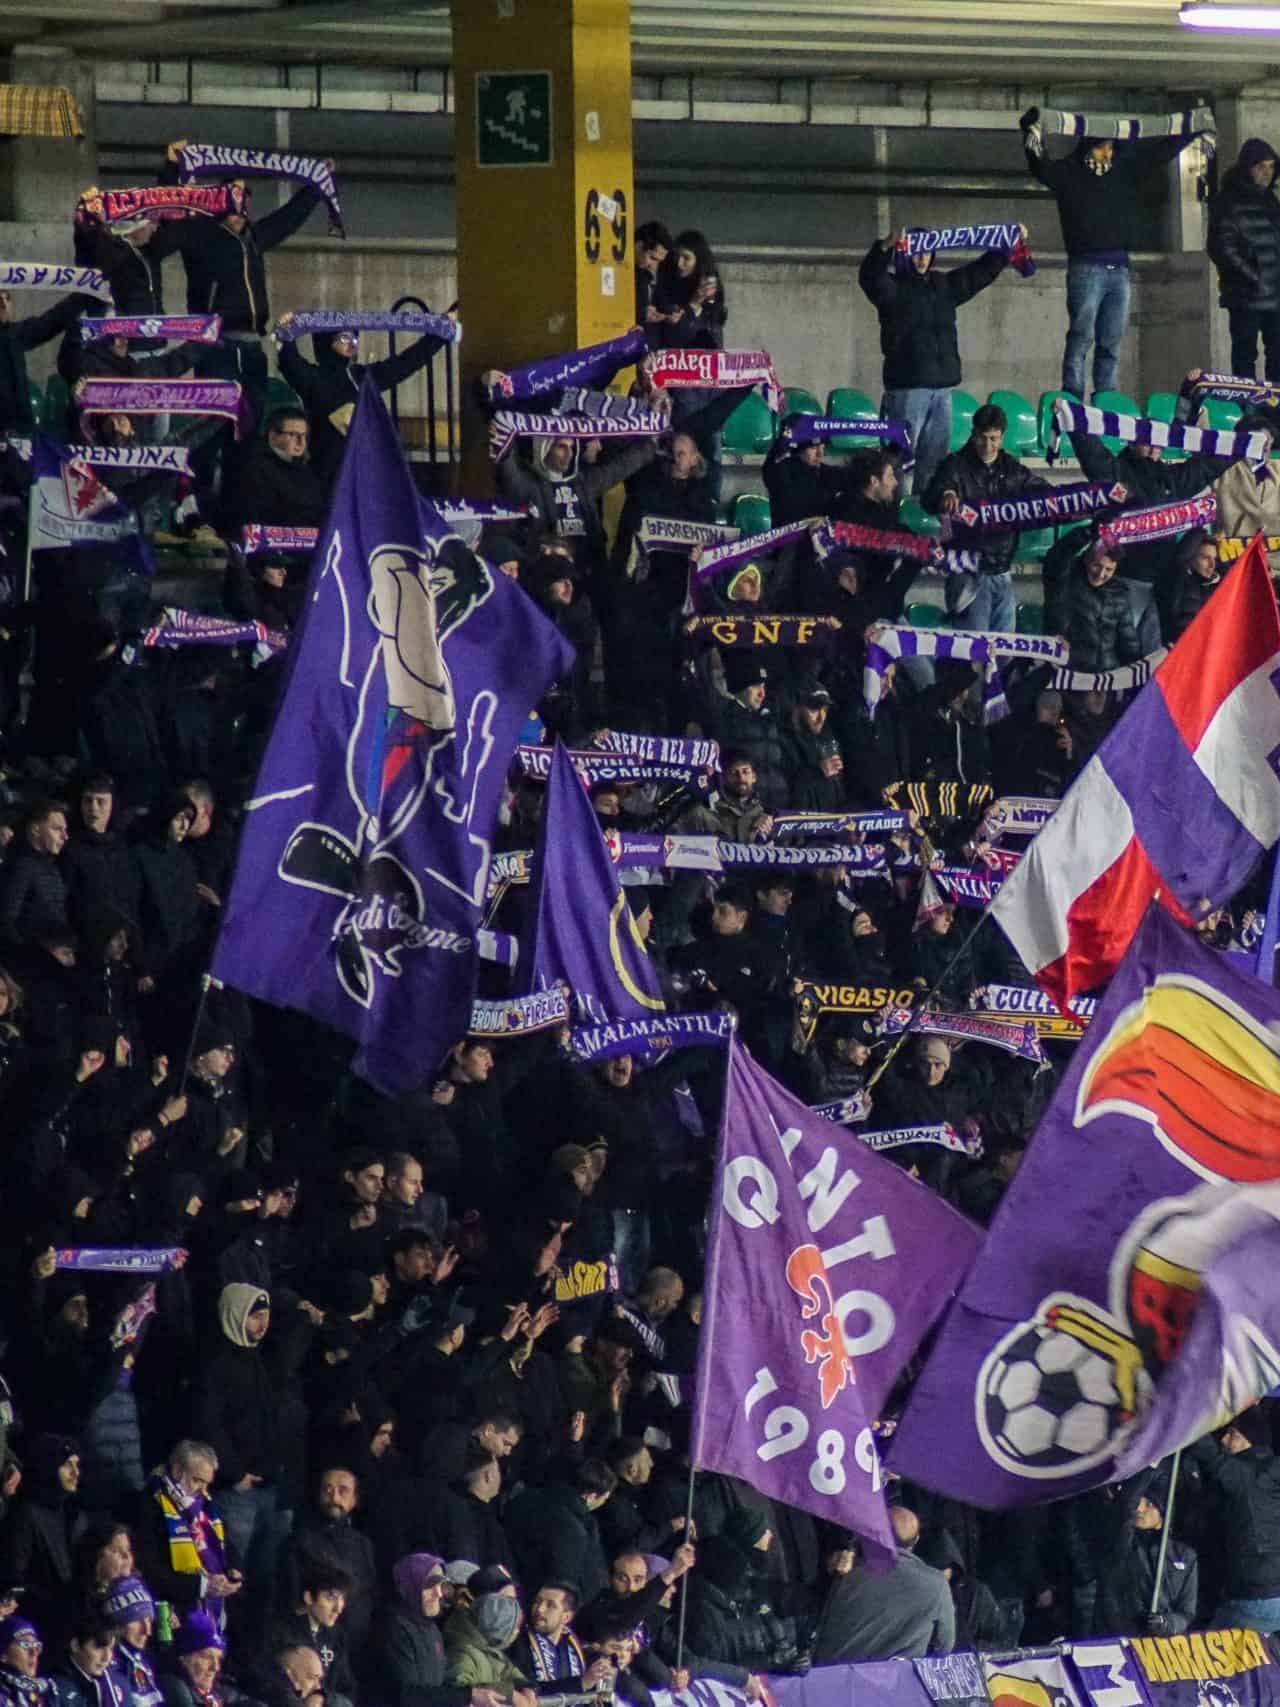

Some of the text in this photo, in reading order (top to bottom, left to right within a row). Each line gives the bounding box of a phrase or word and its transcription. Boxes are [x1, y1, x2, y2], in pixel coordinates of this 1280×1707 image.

[76, 444, 178, 467] RENTINA
[980, 490, 1108, 524] FIORENTINA
[813, 983, 915, 1009] VIGASIO
[581, 1014, 731, 1052] MALMANTILE
